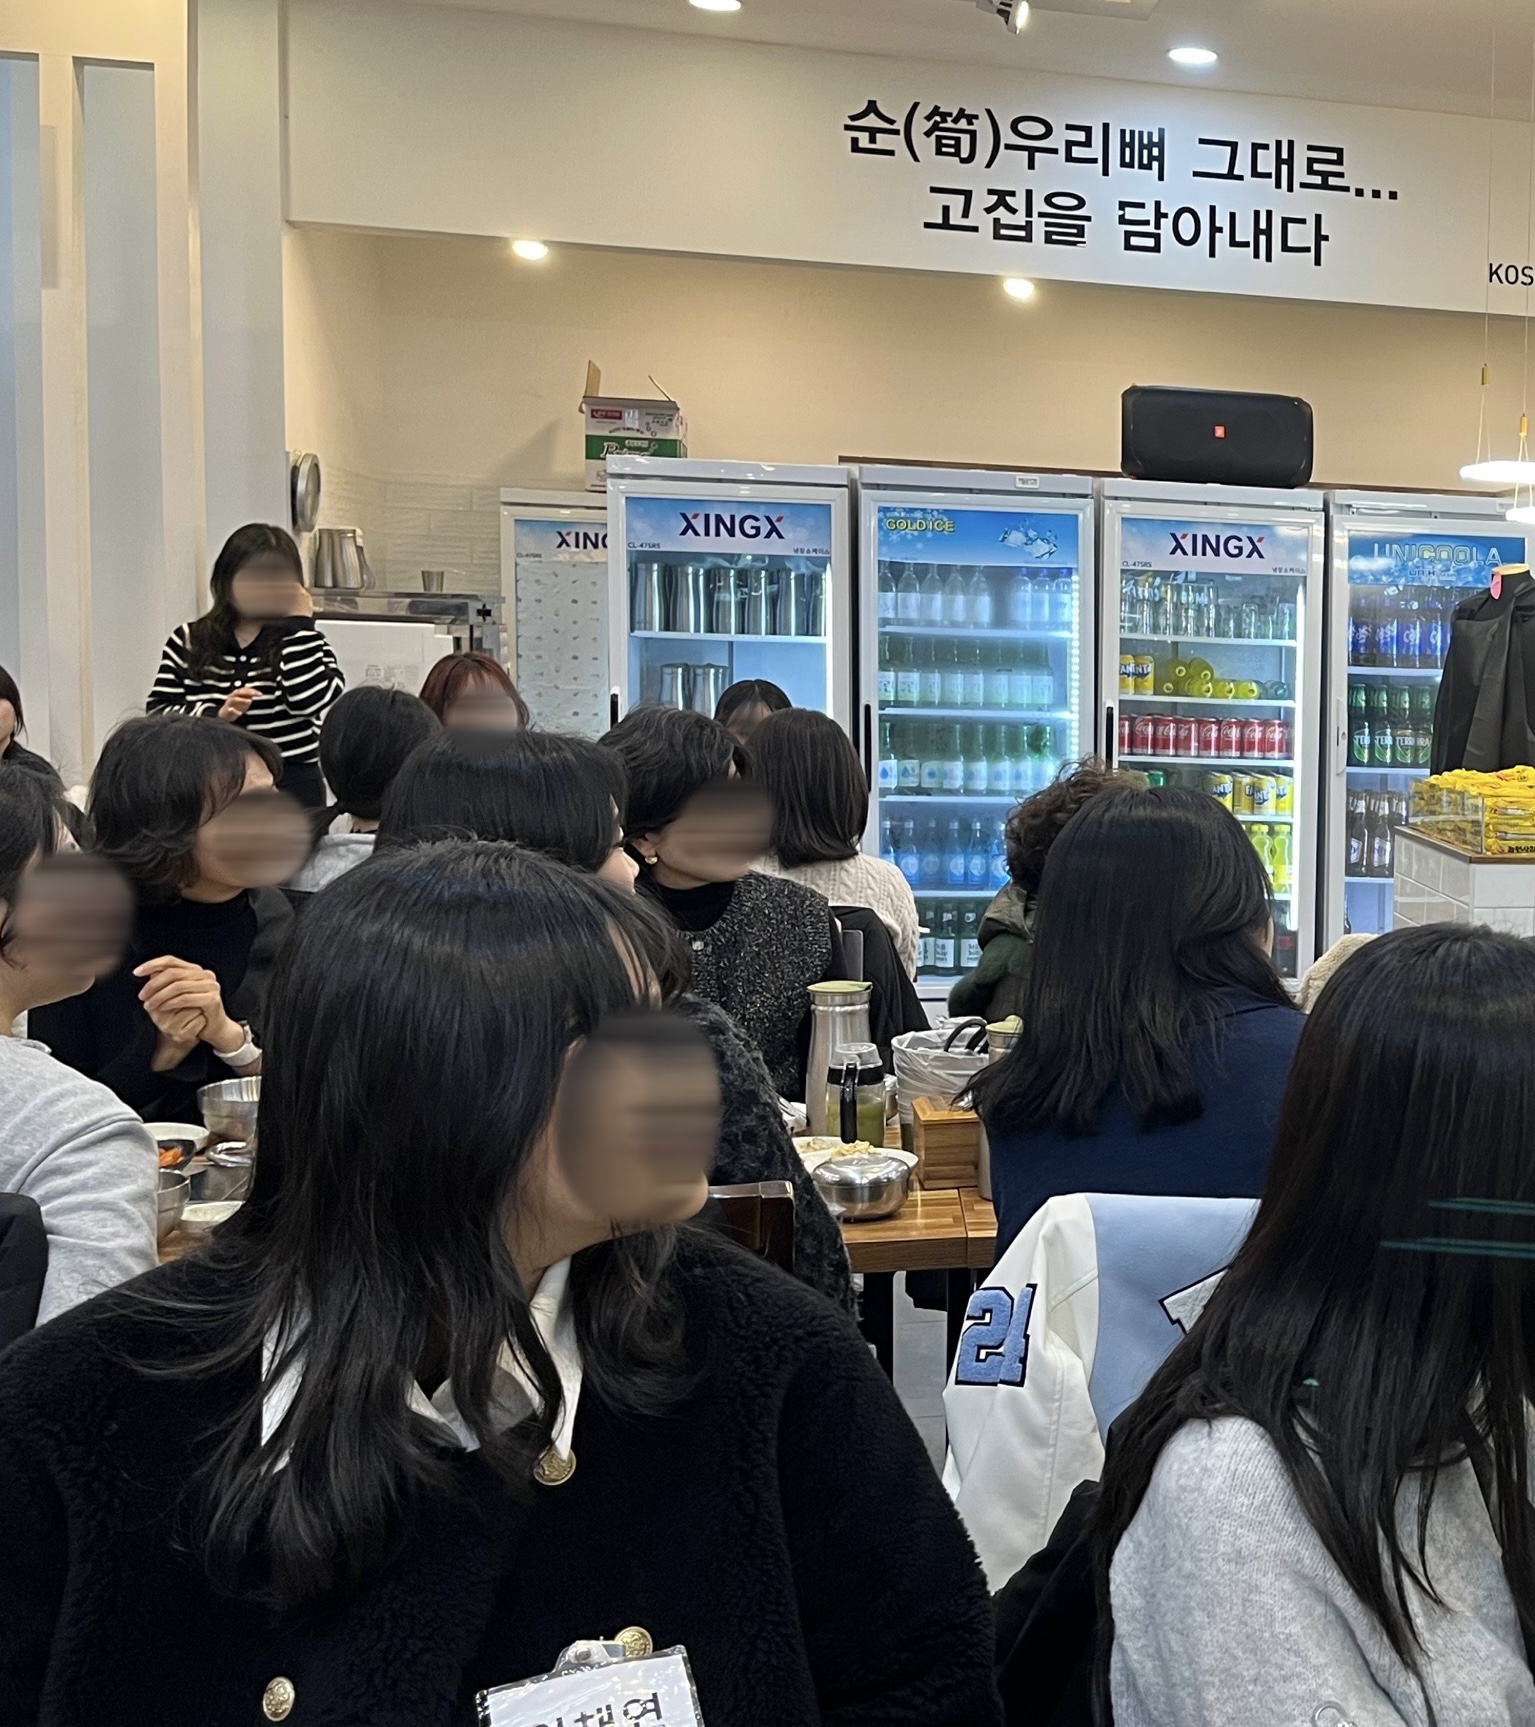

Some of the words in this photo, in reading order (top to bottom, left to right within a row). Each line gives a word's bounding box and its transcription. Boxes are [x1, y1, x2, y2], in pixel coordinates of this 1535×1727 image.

[1192, 136, 1399, 201] 그대로...
[923, 184, 1092, 248] 고집을
[1117, 199, 1330, 267] 담아내다
[679, 512, 785, 540] XINGX
[1169, 532, 1265, 560] XINGX
[954, 1282, 1038, 1388] 21
